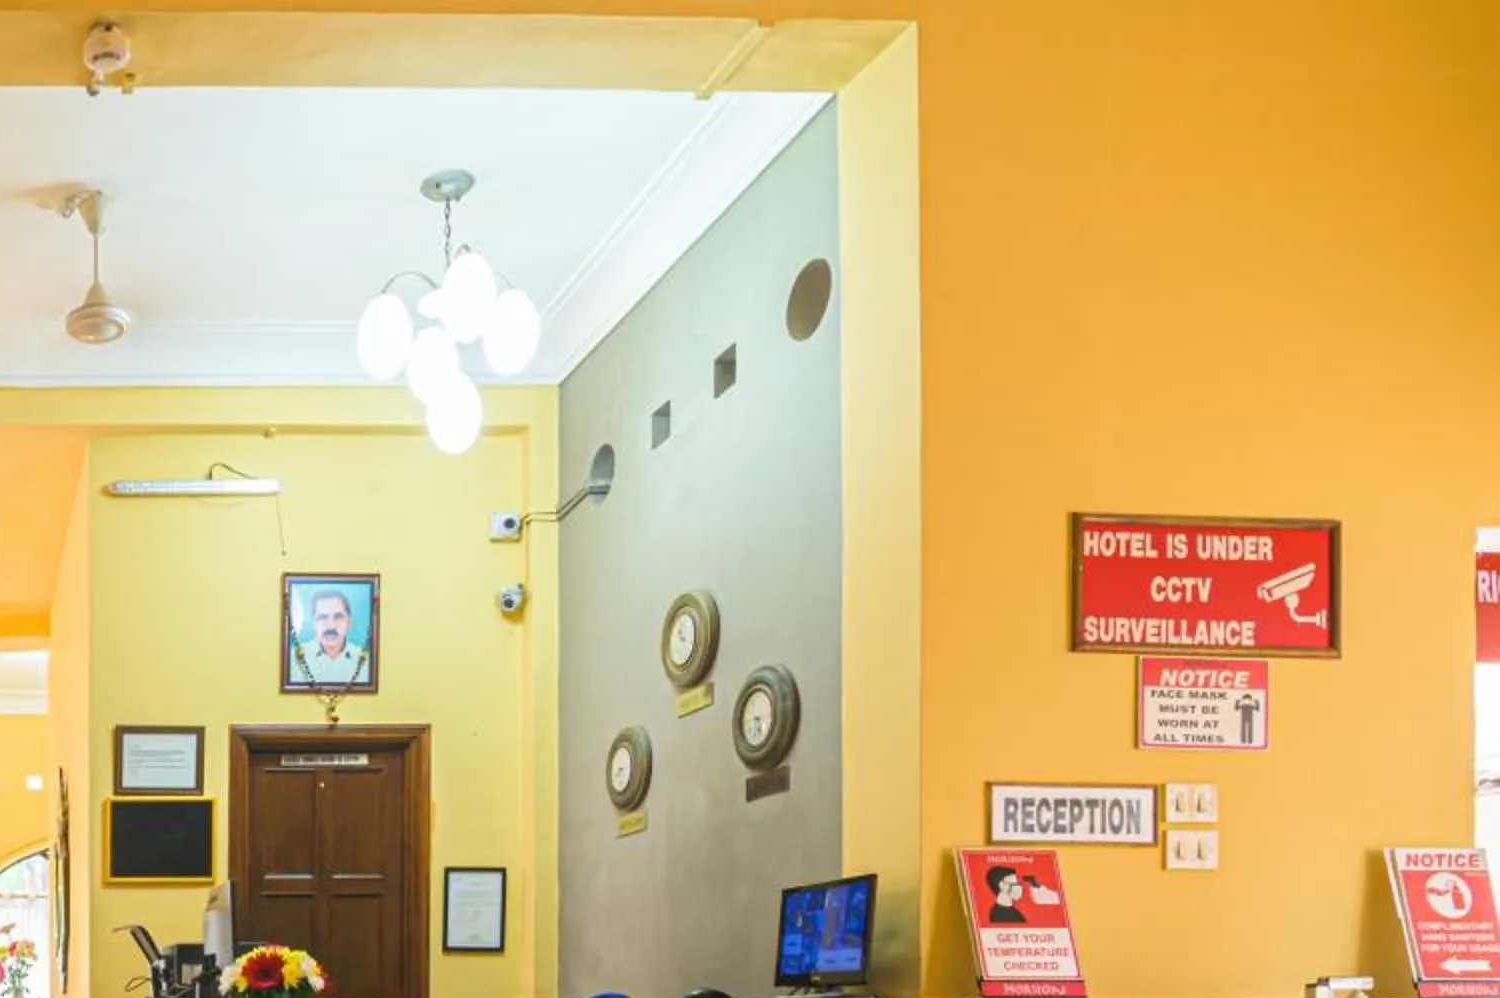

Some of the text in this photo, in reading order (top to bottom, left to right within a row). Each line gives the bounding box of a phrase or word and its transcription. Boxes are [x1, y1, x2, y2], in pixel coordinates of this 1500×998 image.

[1083, 531, 1273, 561] HOTEL IS UNDER
[1150, 576, 1212, 603] CCTV
[1477, 569, 1500, 604] RI
[1084, 616, 1255, 646] SURVEILLANCE
[1160, 669, 1250, 689] NOTICE
[1150, 690, 1228, 700] FACE MASK
[1159, 704, 1220, 715] MUST BE
[1158, 719, 1220, 729] WORN AT
[1153, 733, 1224, 743] ALL TIMES
[1003, 797, 1141, 835] RECEPTION
[1405, 853, 1481, 867] NOTICE
[997, 933, 1055, 943] GET YOUR
[987, 947, 1069, 957] TEMPERATURE
[1004, 961, 1059, 971] CHECKED
